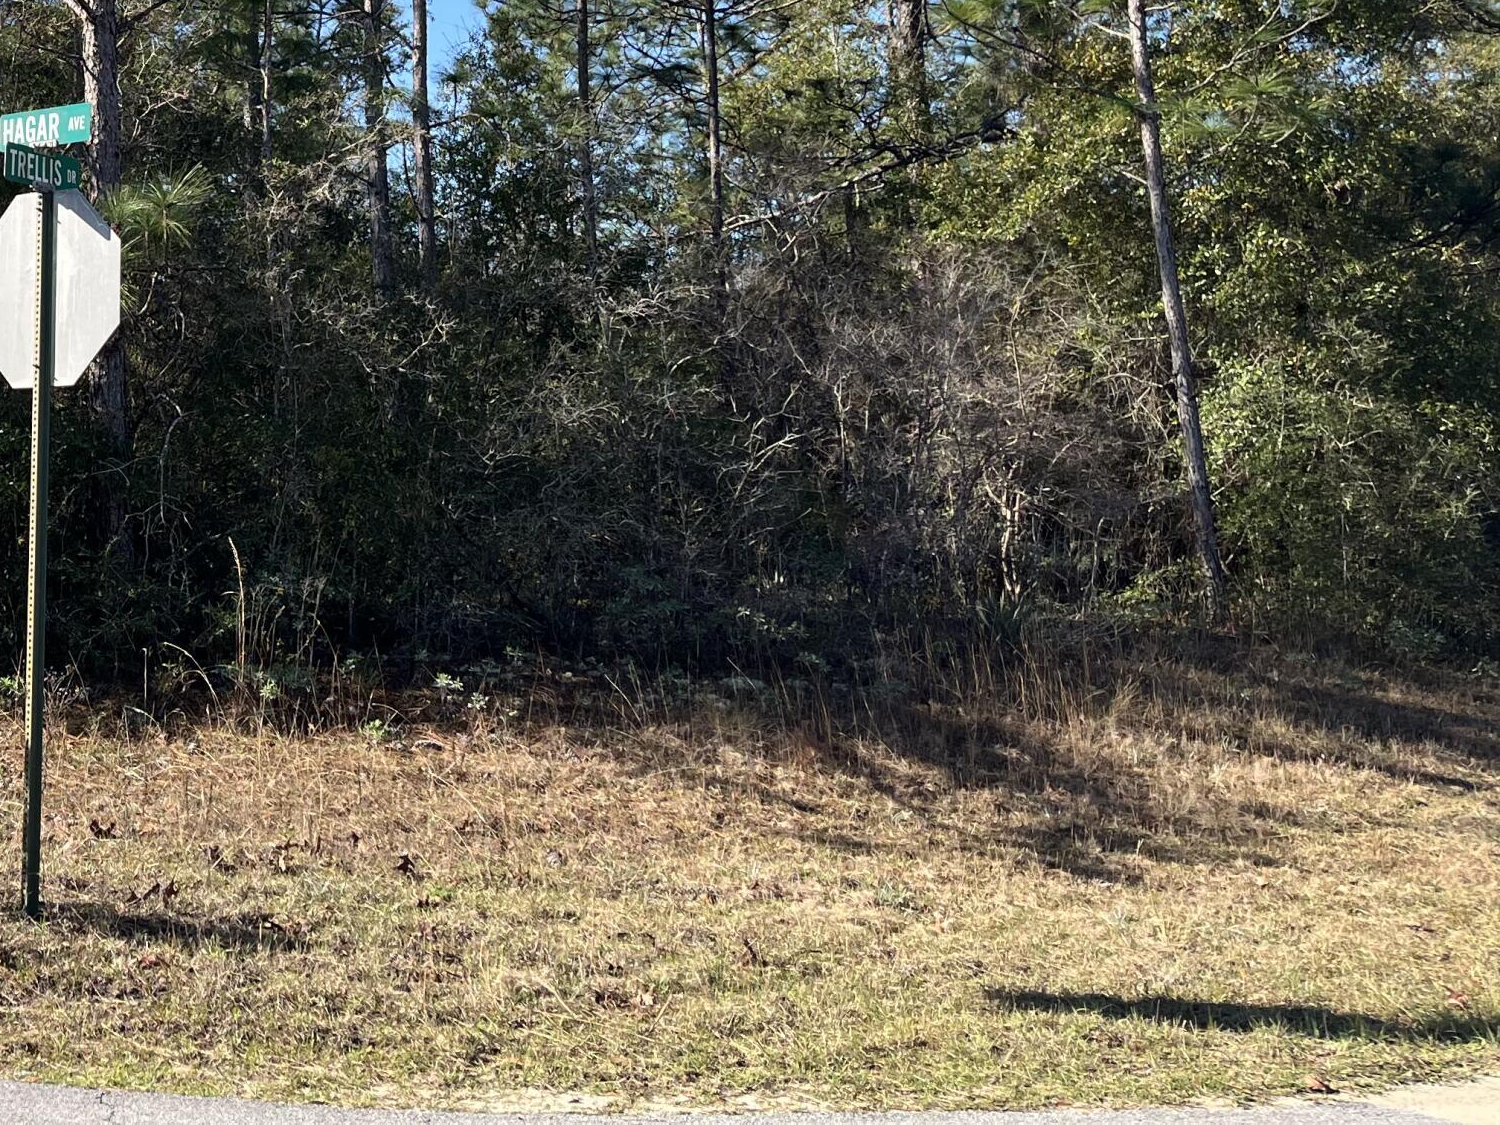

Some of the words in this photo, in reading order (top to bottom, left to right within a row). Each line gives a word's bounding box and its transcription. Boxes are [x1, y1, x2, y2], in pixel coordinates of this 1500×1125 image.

[3, 112, 60, 143] HAGAR
[68, 115, 85, 132] AVE
[10, 149, 62, 187] TRELLIS
[67, 169, 77, 185] DR
